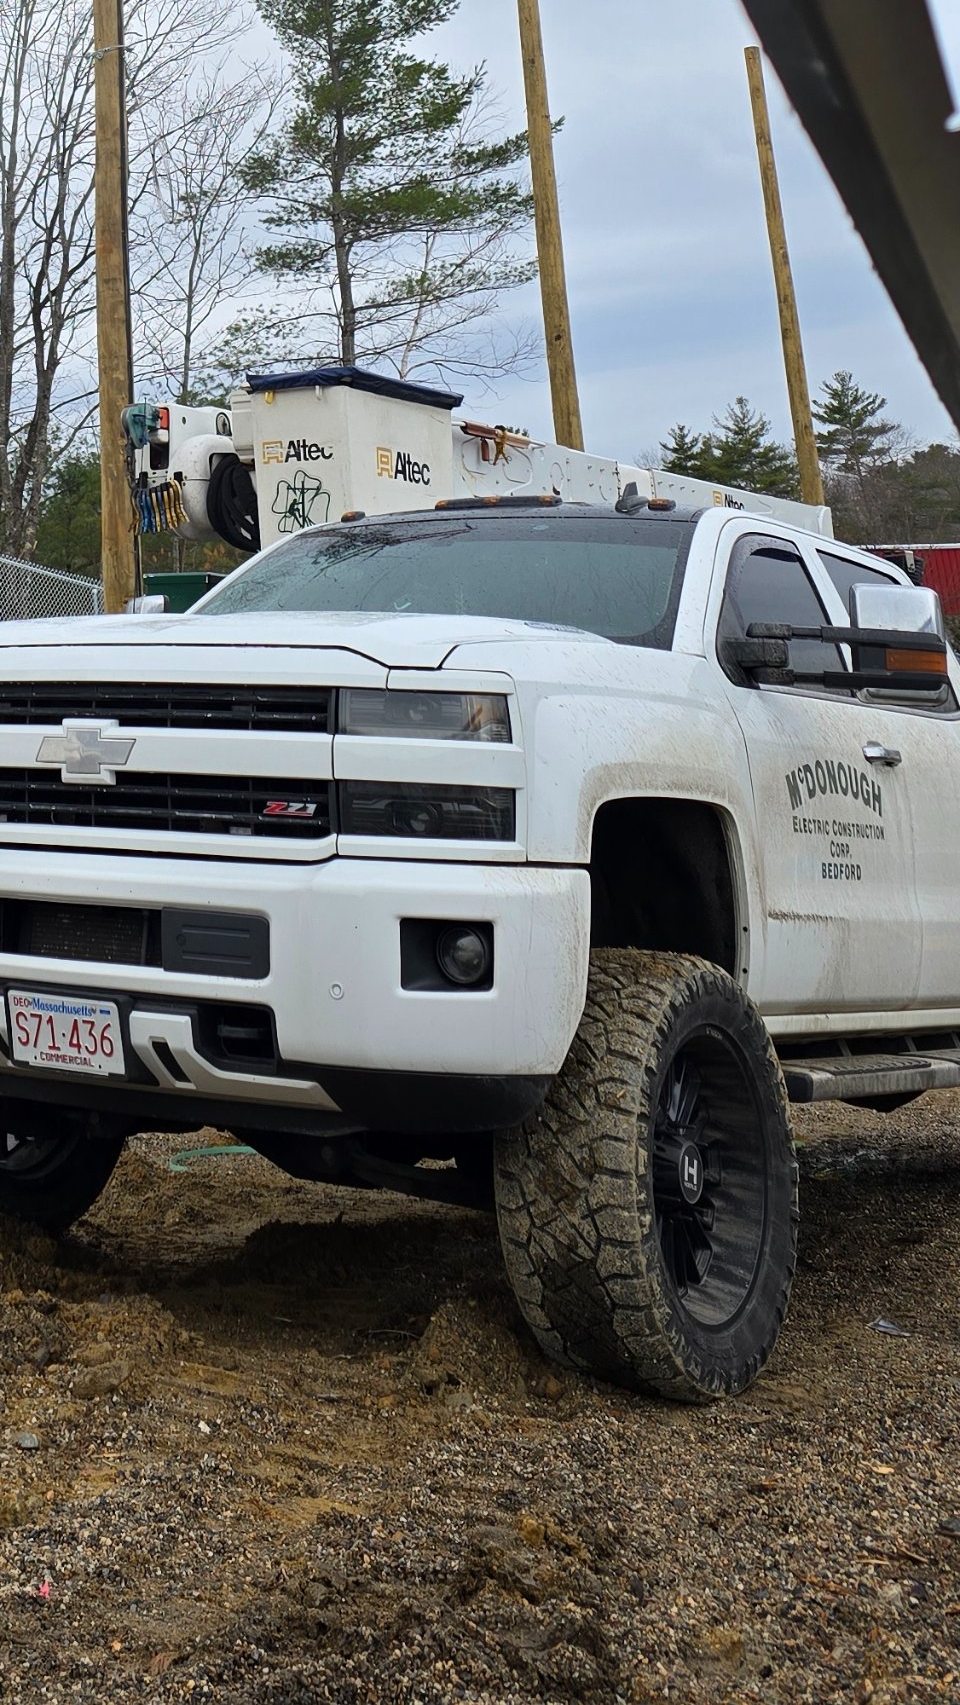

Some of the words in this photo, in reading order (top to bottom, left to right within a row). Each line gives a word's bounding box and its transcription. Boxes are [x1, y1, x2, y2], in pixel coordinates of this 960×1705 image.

[284, 438, 334, 463] Altec
[394, 451, 431, 486] Altec
[263, 801, 318, 816] Z71
[821, 862, 862, 881] BEDFORD
[31, 997, 93, 1017] Massachusetts
[40, 1051, 94, 1068] COMMERCIAL
